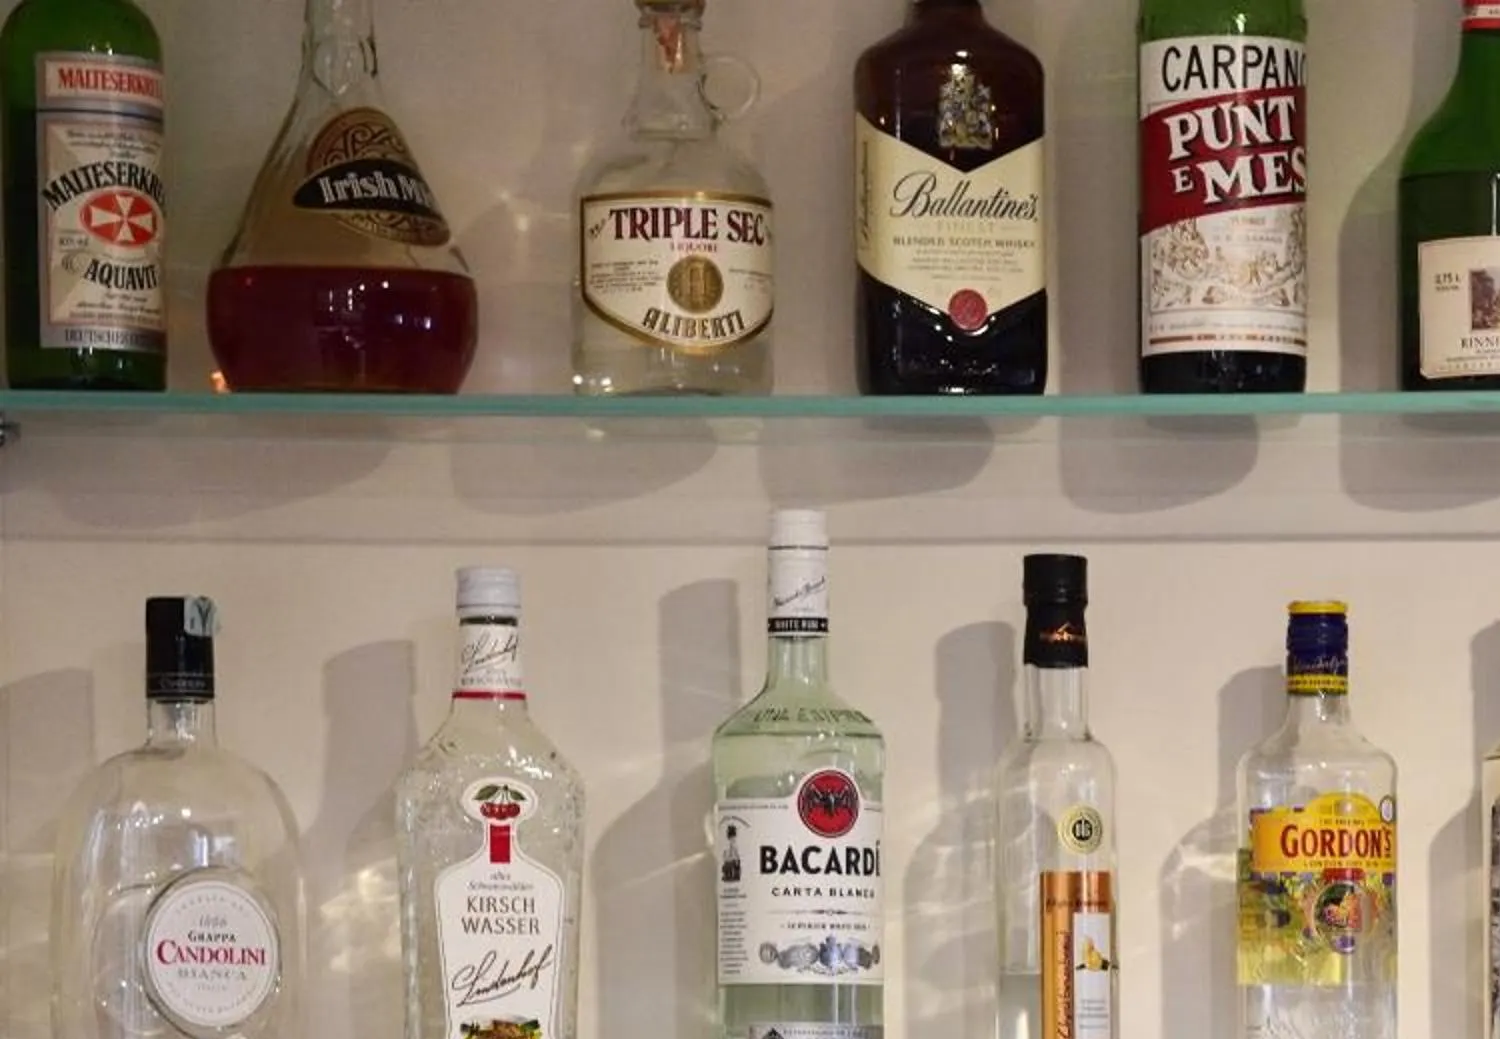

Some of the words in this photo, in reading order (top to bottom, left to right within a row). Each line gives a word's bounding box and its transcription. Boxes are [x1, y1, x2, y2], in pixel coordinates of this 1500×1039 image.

[1162, 95, 1297, 160] PUNT
[318, 170, 399, 204] Irish
[1170, 165, 1194, 193] E
[1196, 146, 1306, 204] MES
[609, 207, 718, 241] TRIPLE
[726, 209, 765, 246] SEC
[84, 258, 158, 291] AQUAVIT
[1280, 824, 1392, 858] GORDON'S
[466, 895, 535, 914] KIRSCH
[771, 887, 823, 897] CARTA
[461, 917, 541, 935] WASSER
[156, 939, 266, 966] CANDOLINI
